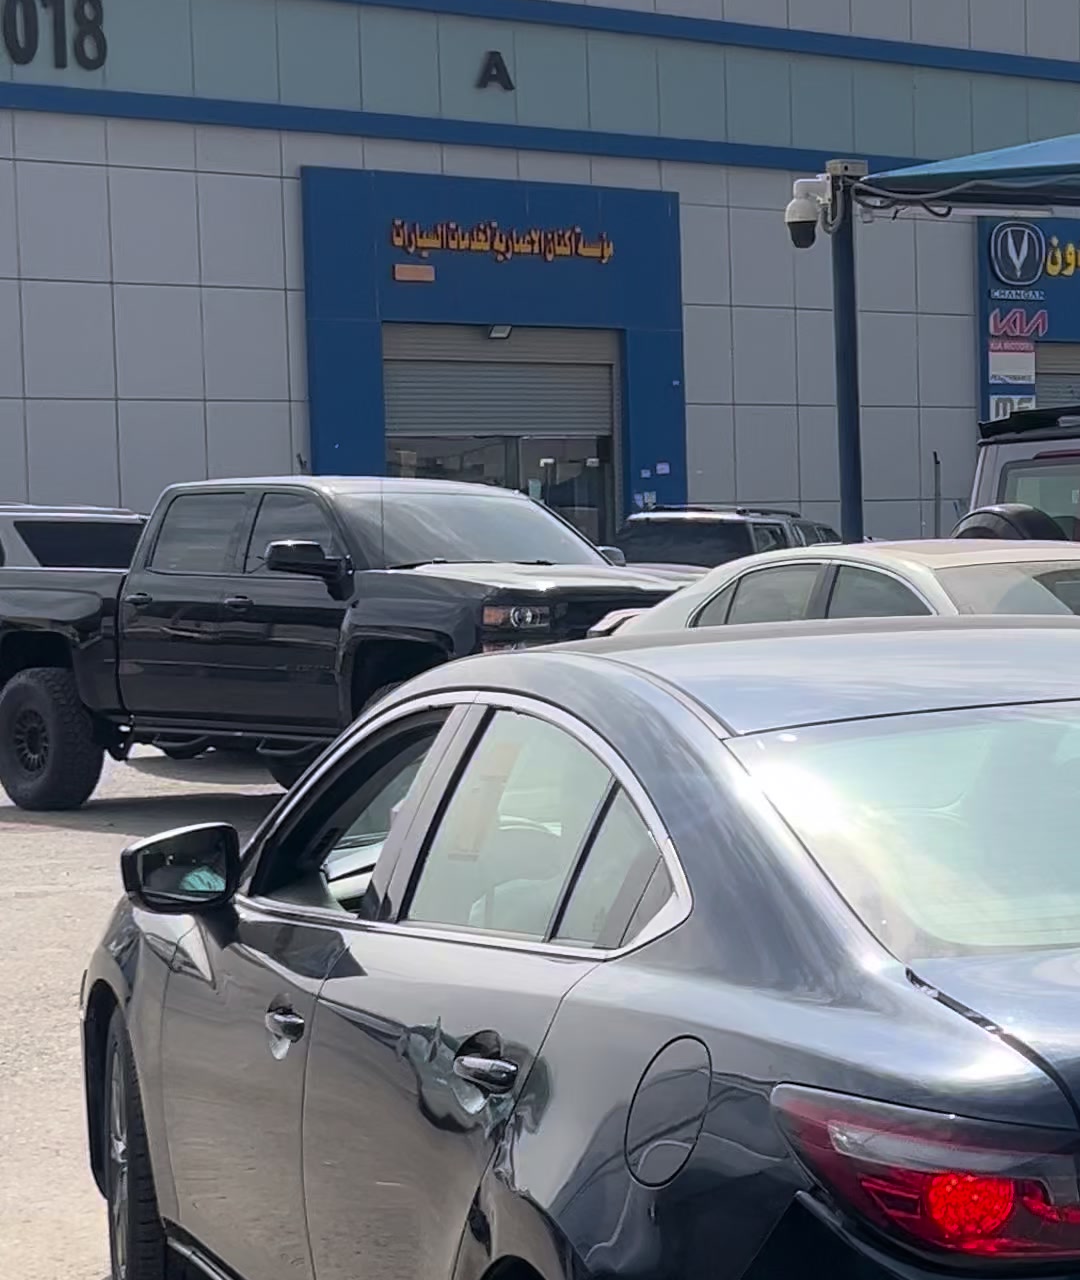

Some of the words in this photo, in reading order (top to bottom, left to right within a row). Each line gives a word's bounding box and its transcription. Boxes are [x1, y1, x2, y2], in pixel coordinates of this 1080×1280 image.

[476, 51, 515, 92] A
[392, 218, 447, 258] السيارات
[575, 224, 614, 264] مؤسسة
[990, 289, 1045, 300] CHANGAN
